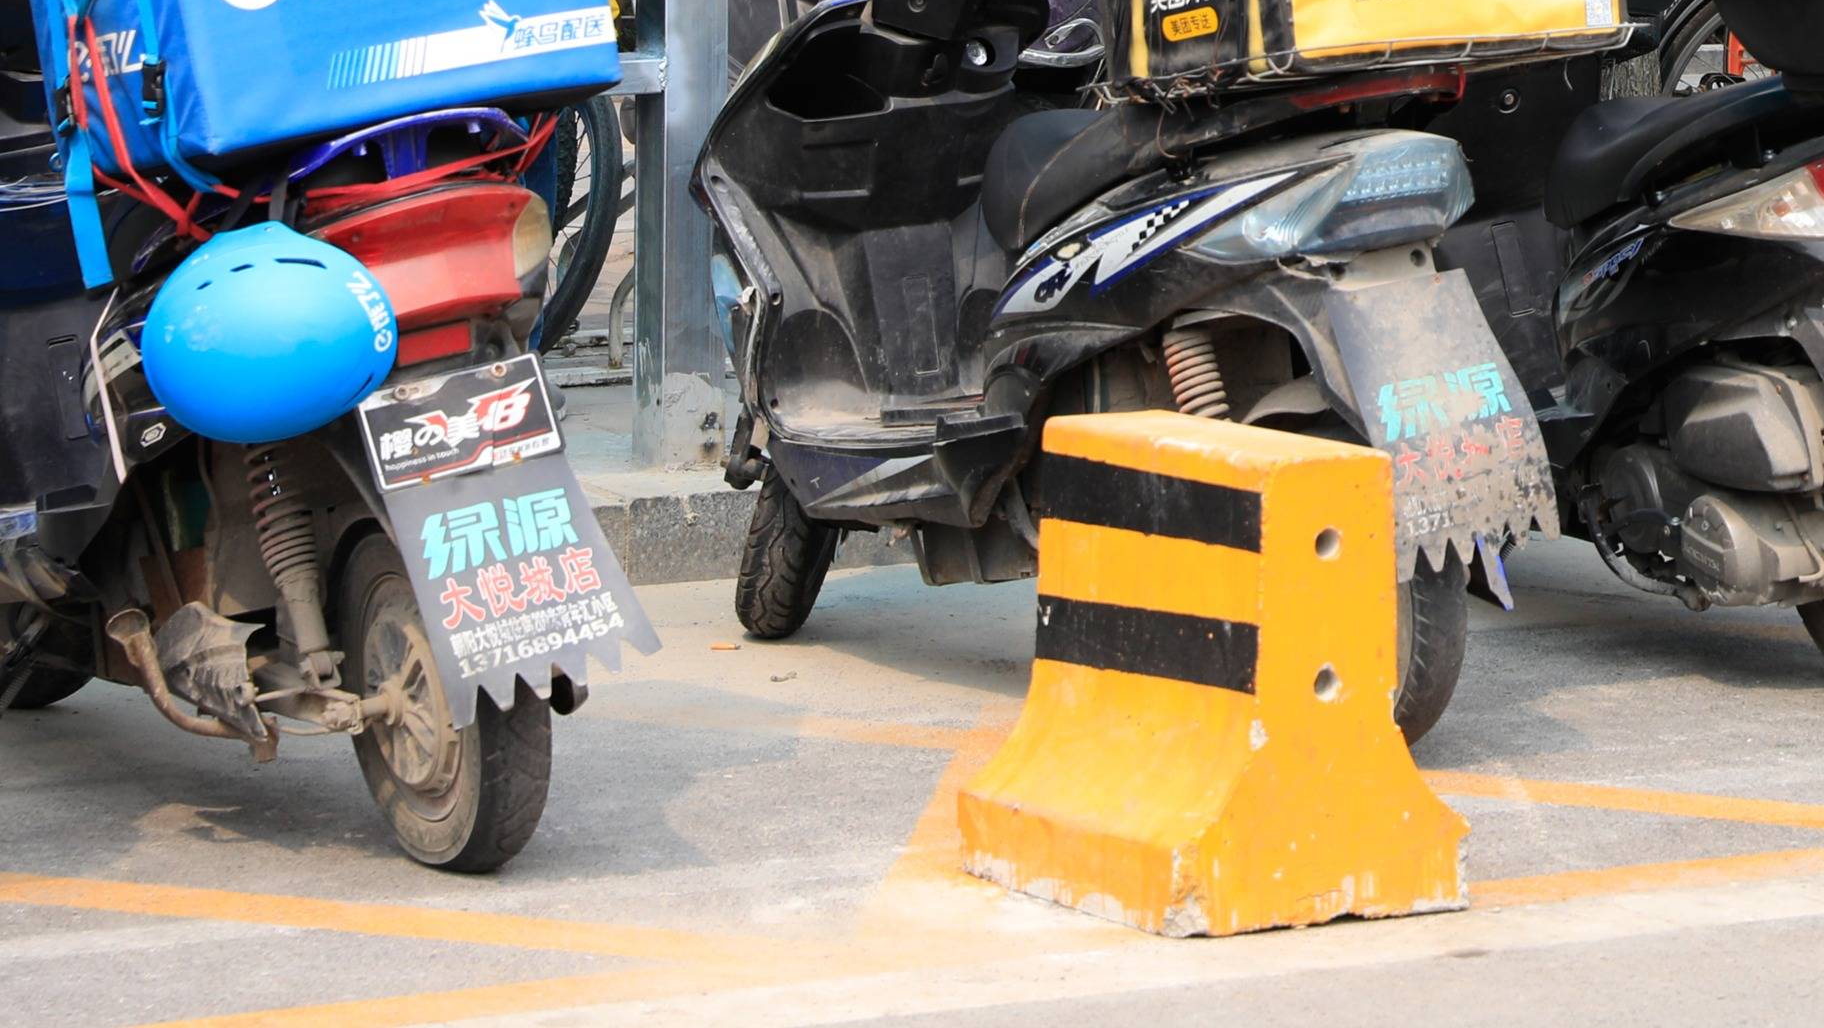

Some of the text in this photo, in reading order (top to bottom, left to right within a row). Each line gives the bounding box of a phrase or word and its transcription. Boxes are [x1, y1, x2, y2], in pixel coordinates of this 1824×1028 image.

[420, 488, 579, 580] 绿源
[440, 546, 602, 630] 大悦城店
[457, 611, 625, 679] 13716894454
